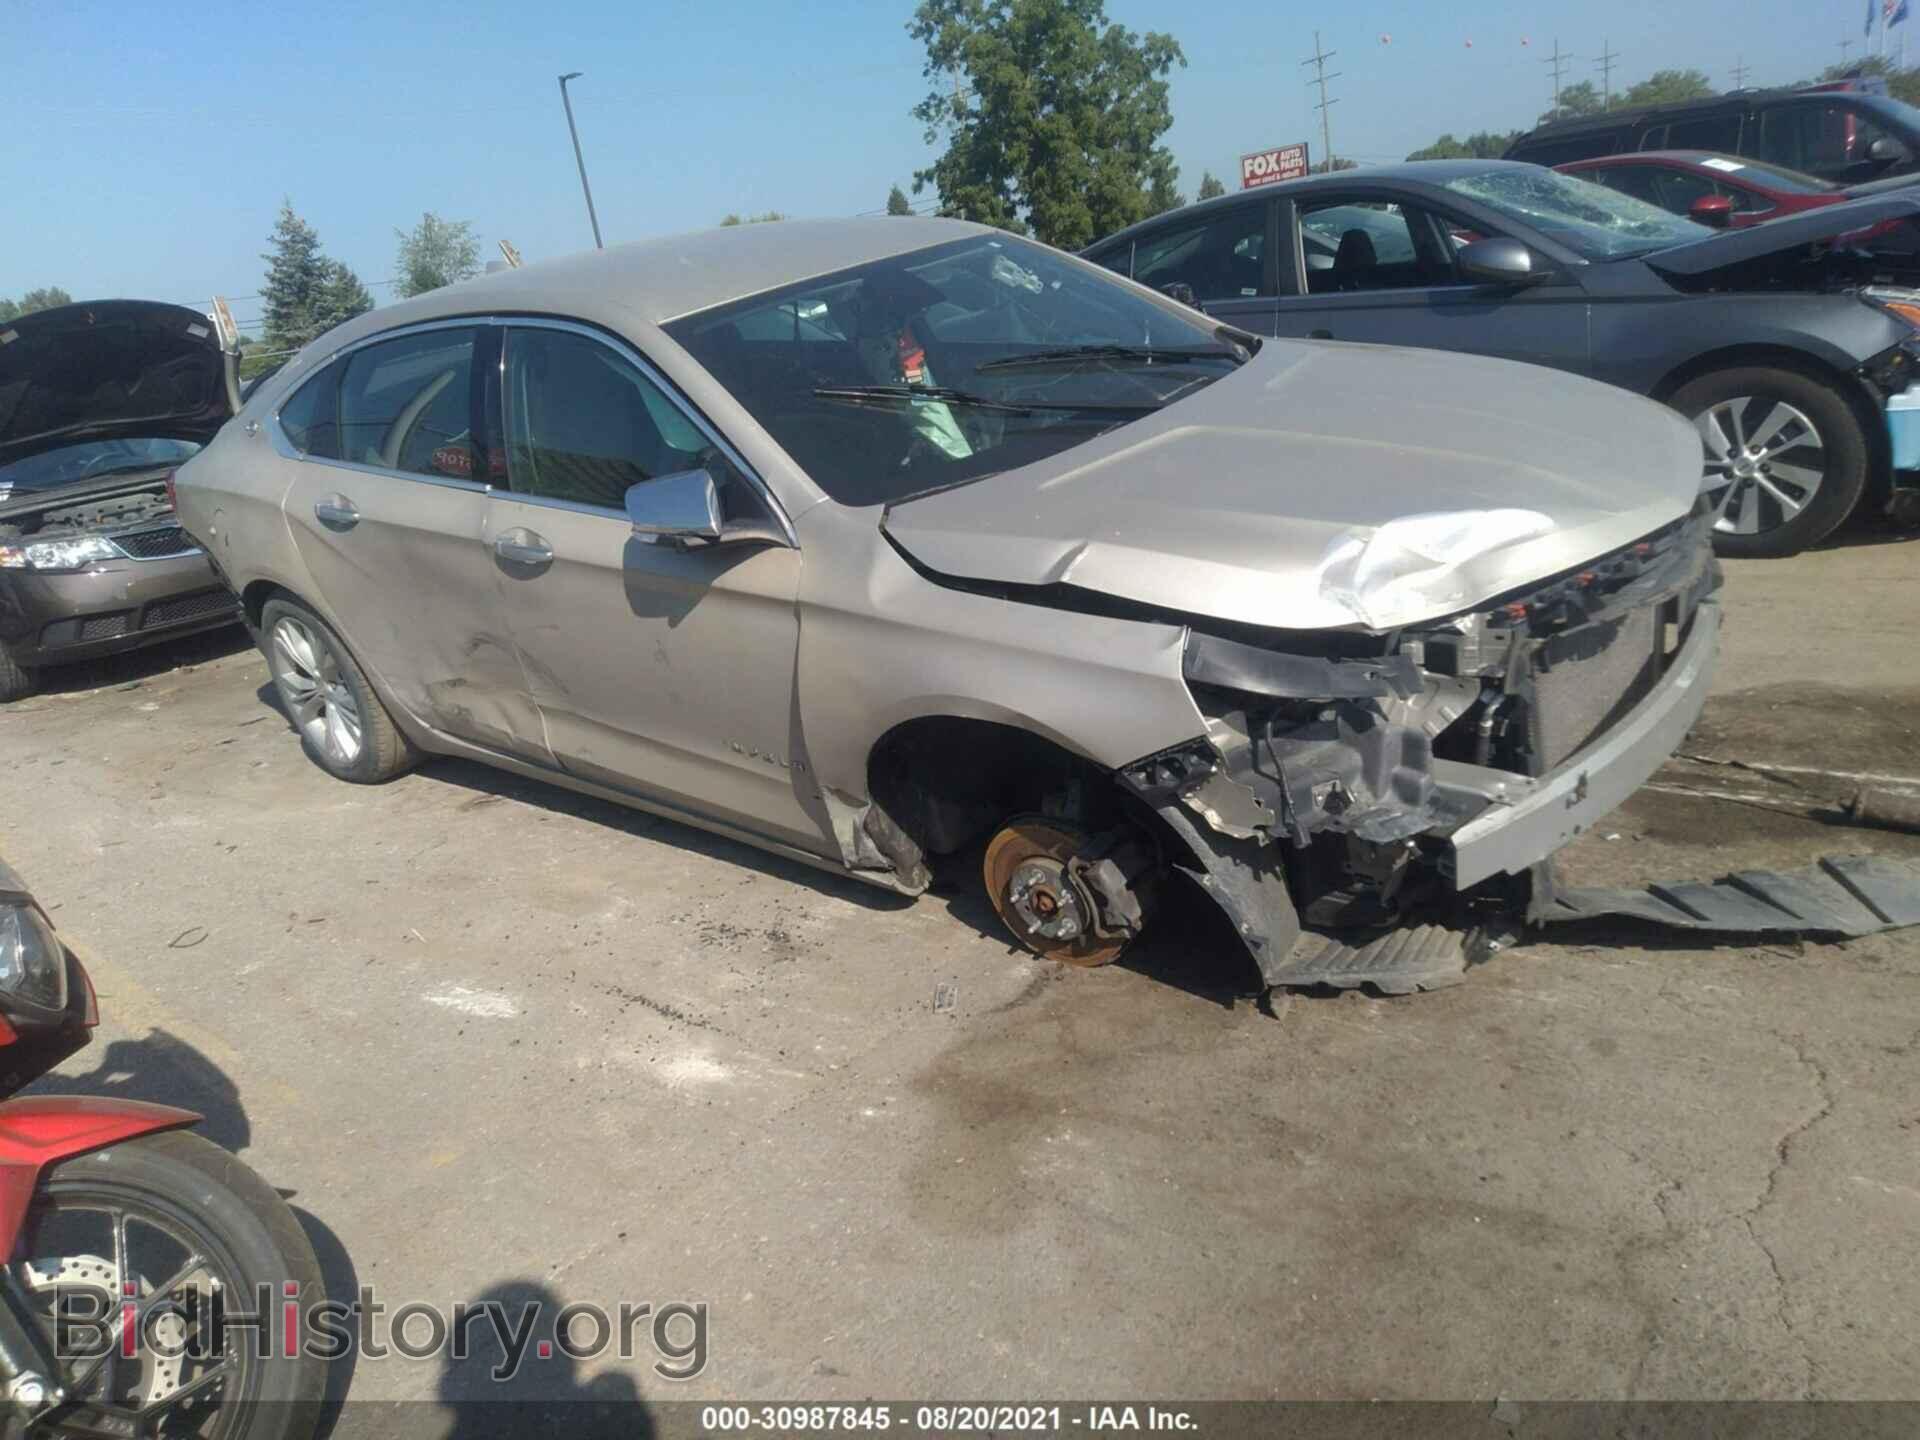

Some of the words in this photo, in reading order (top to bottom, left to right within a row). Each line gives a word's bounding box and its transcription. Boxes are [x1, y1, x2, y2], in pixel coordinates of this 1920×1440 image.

[1280, 148, 1301, 161] AUTO
[1244, 152, 1280, 179] FOX
[1280, 157, 1304, 171] PARTS
